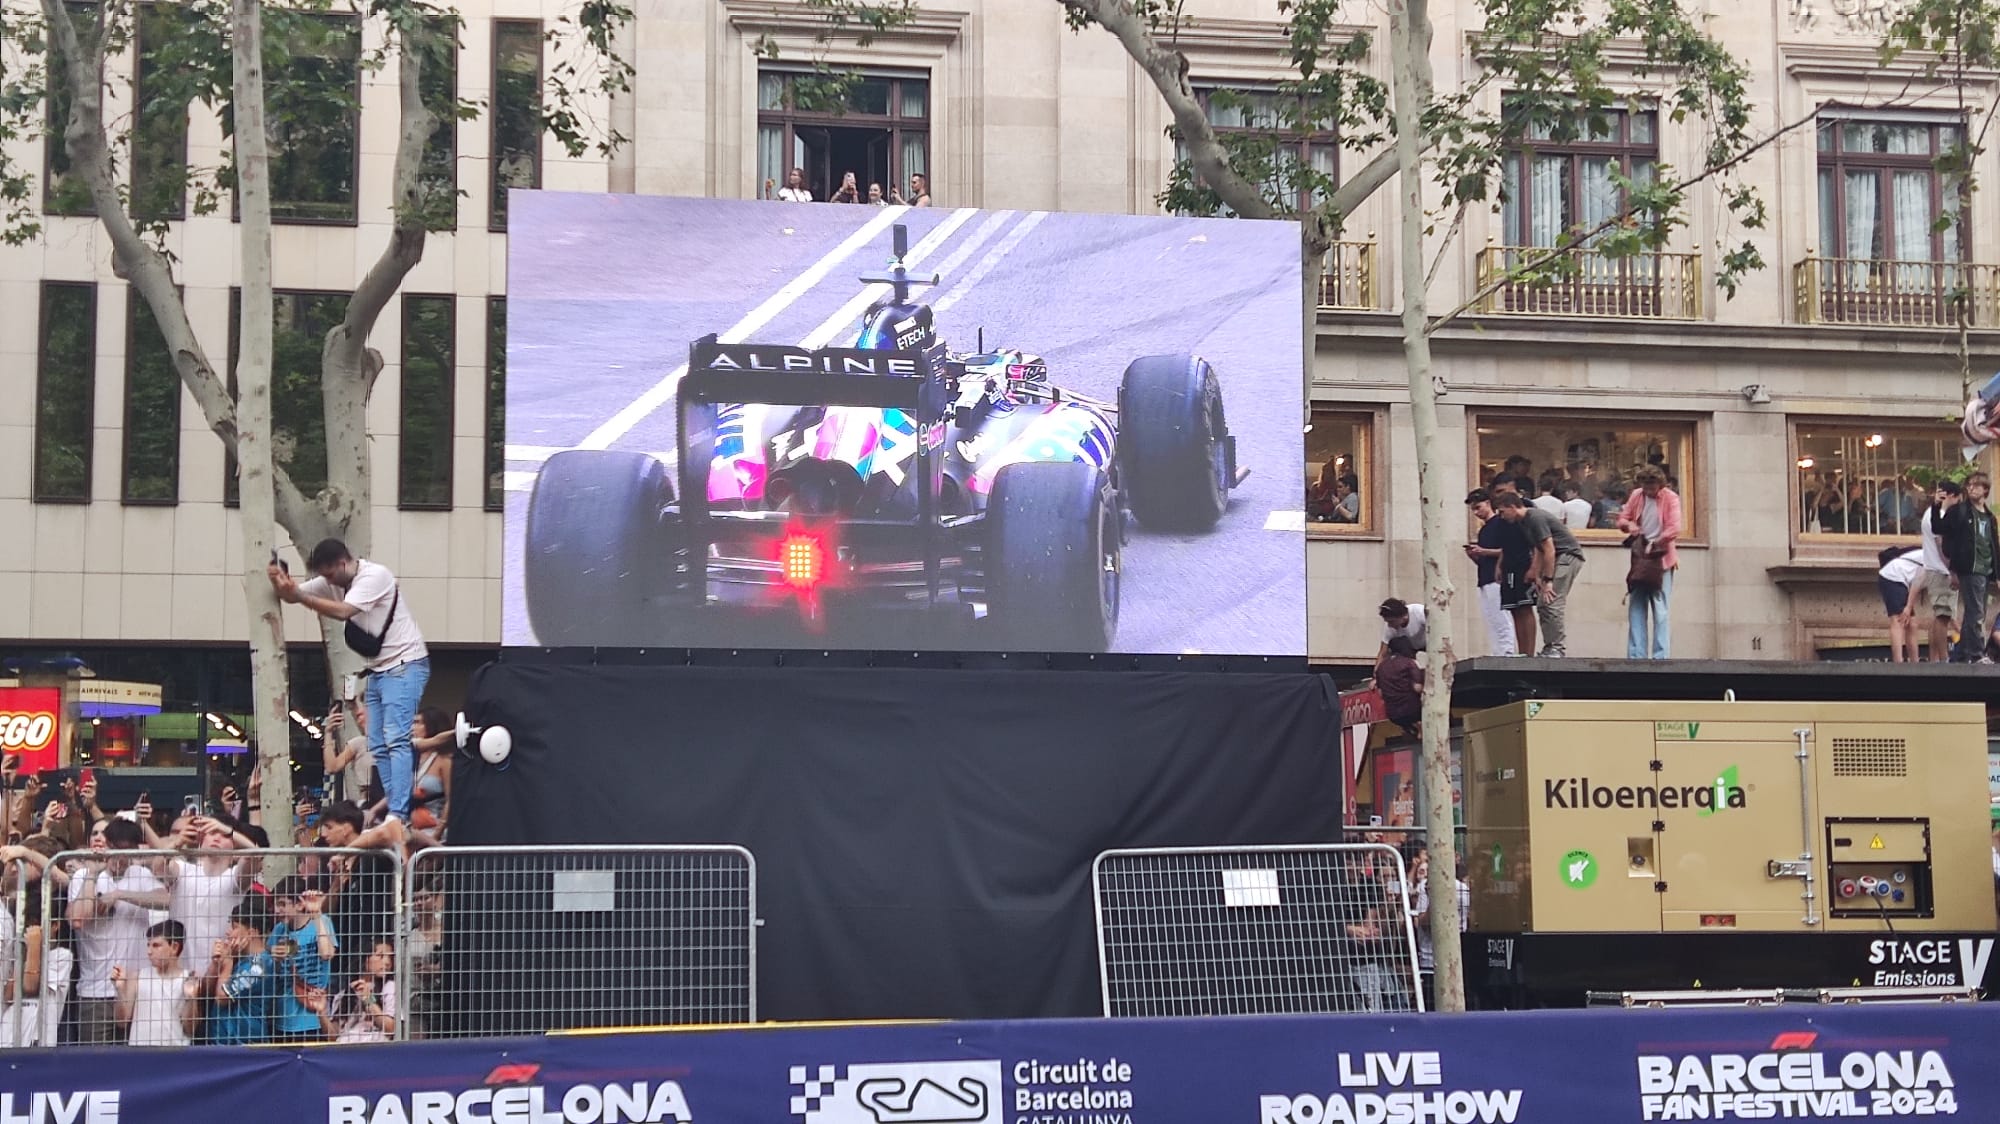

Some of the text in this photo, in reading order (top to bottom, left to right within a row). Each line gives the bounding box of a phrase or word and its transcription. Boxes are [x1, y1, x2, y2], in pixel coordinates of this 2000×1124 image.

[709, 352, 915, 376] ALPINE
[0, 714, 54, 747] EGO
[1657, 722, 1700, 739] STAGE V
[1545, 777, 1747, 817] Kiloenergia
[1868, 938, 1995, 988] STAGE V
[1874, 969, 1955, 986] Emissions
[1013, 1056, 1132, 1085] Circuit de
[1338, 1051, 1442, 1087] LIVE
[1638, 1050, 1955, 1094] BARCELONA
[0, 1091, 121, 1124] LIVE
[328, 1080, 693, 1124] BARCELONA
[1015, 1085, 1133, 1111] Barcelona
[1260, 1089, 1523, 1124] ROADSHOW
[1641, 1087, 1958, 1121] FAN FESTIVAL 2024
